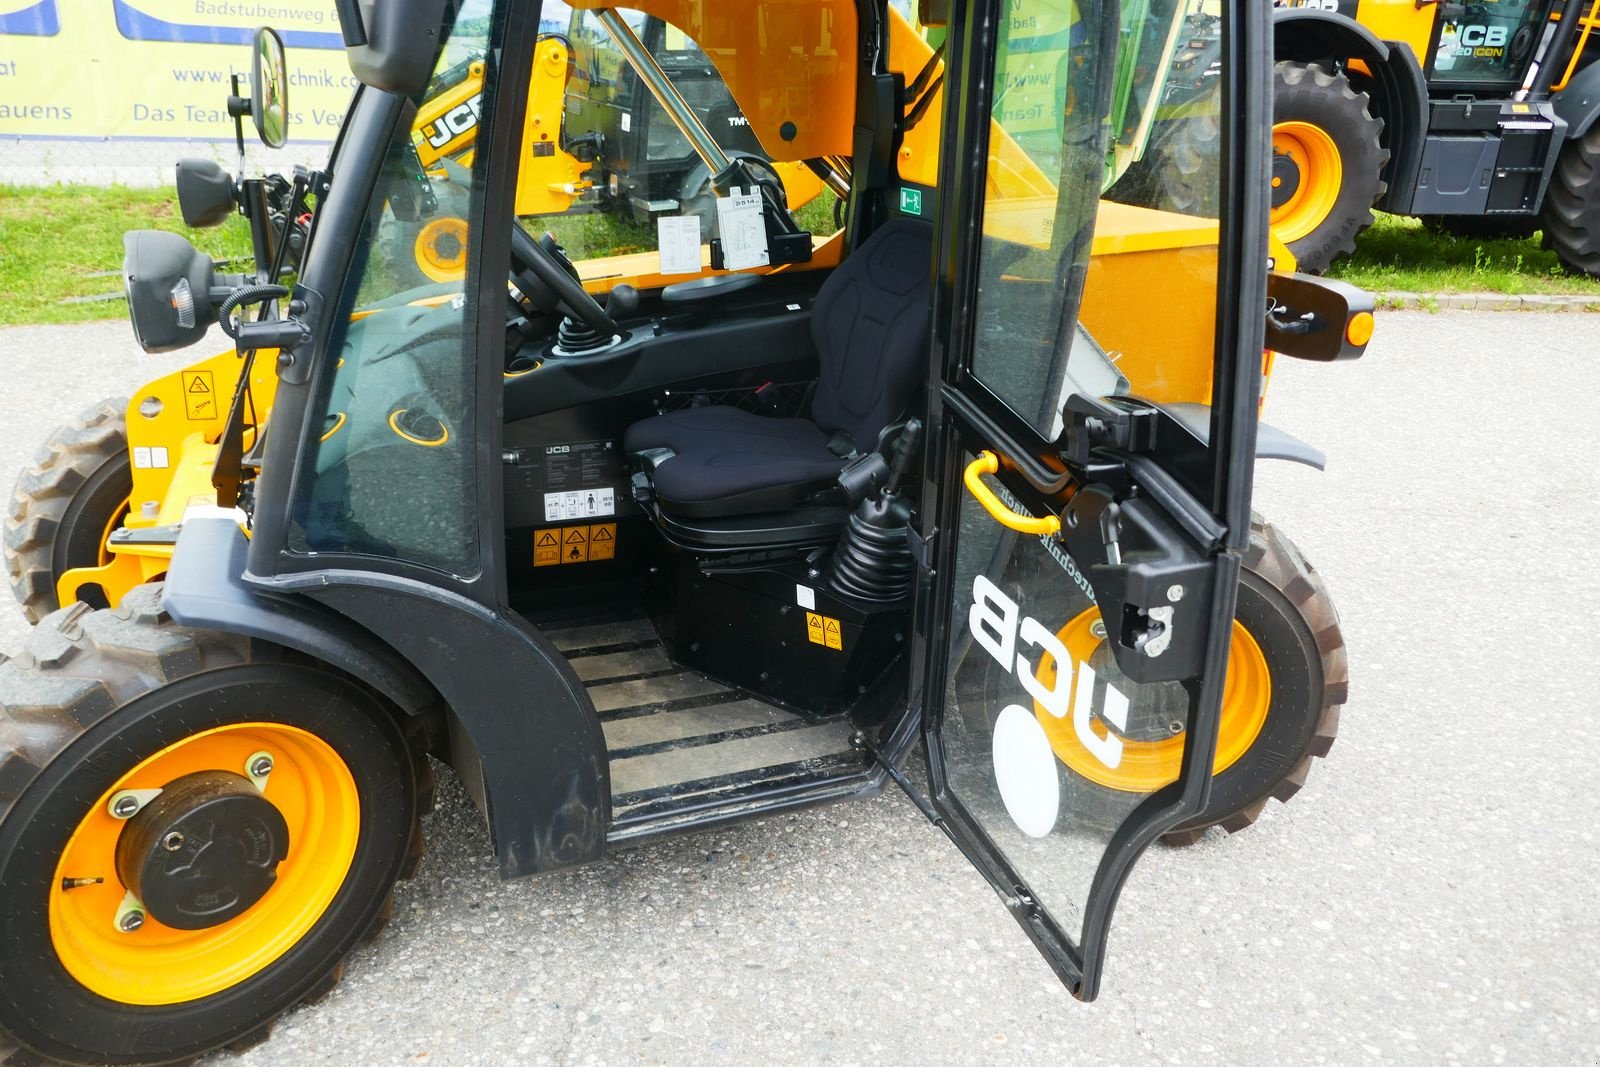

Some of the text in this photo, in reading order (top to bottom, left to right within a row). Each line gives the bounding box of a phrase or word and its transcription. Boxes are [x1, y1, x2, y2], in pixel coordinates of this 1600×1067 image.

[194, 0, 325, 24] Badstubenweg
[134, 103, 175, 122] Das
[546, 446, 570, 455] JCB
